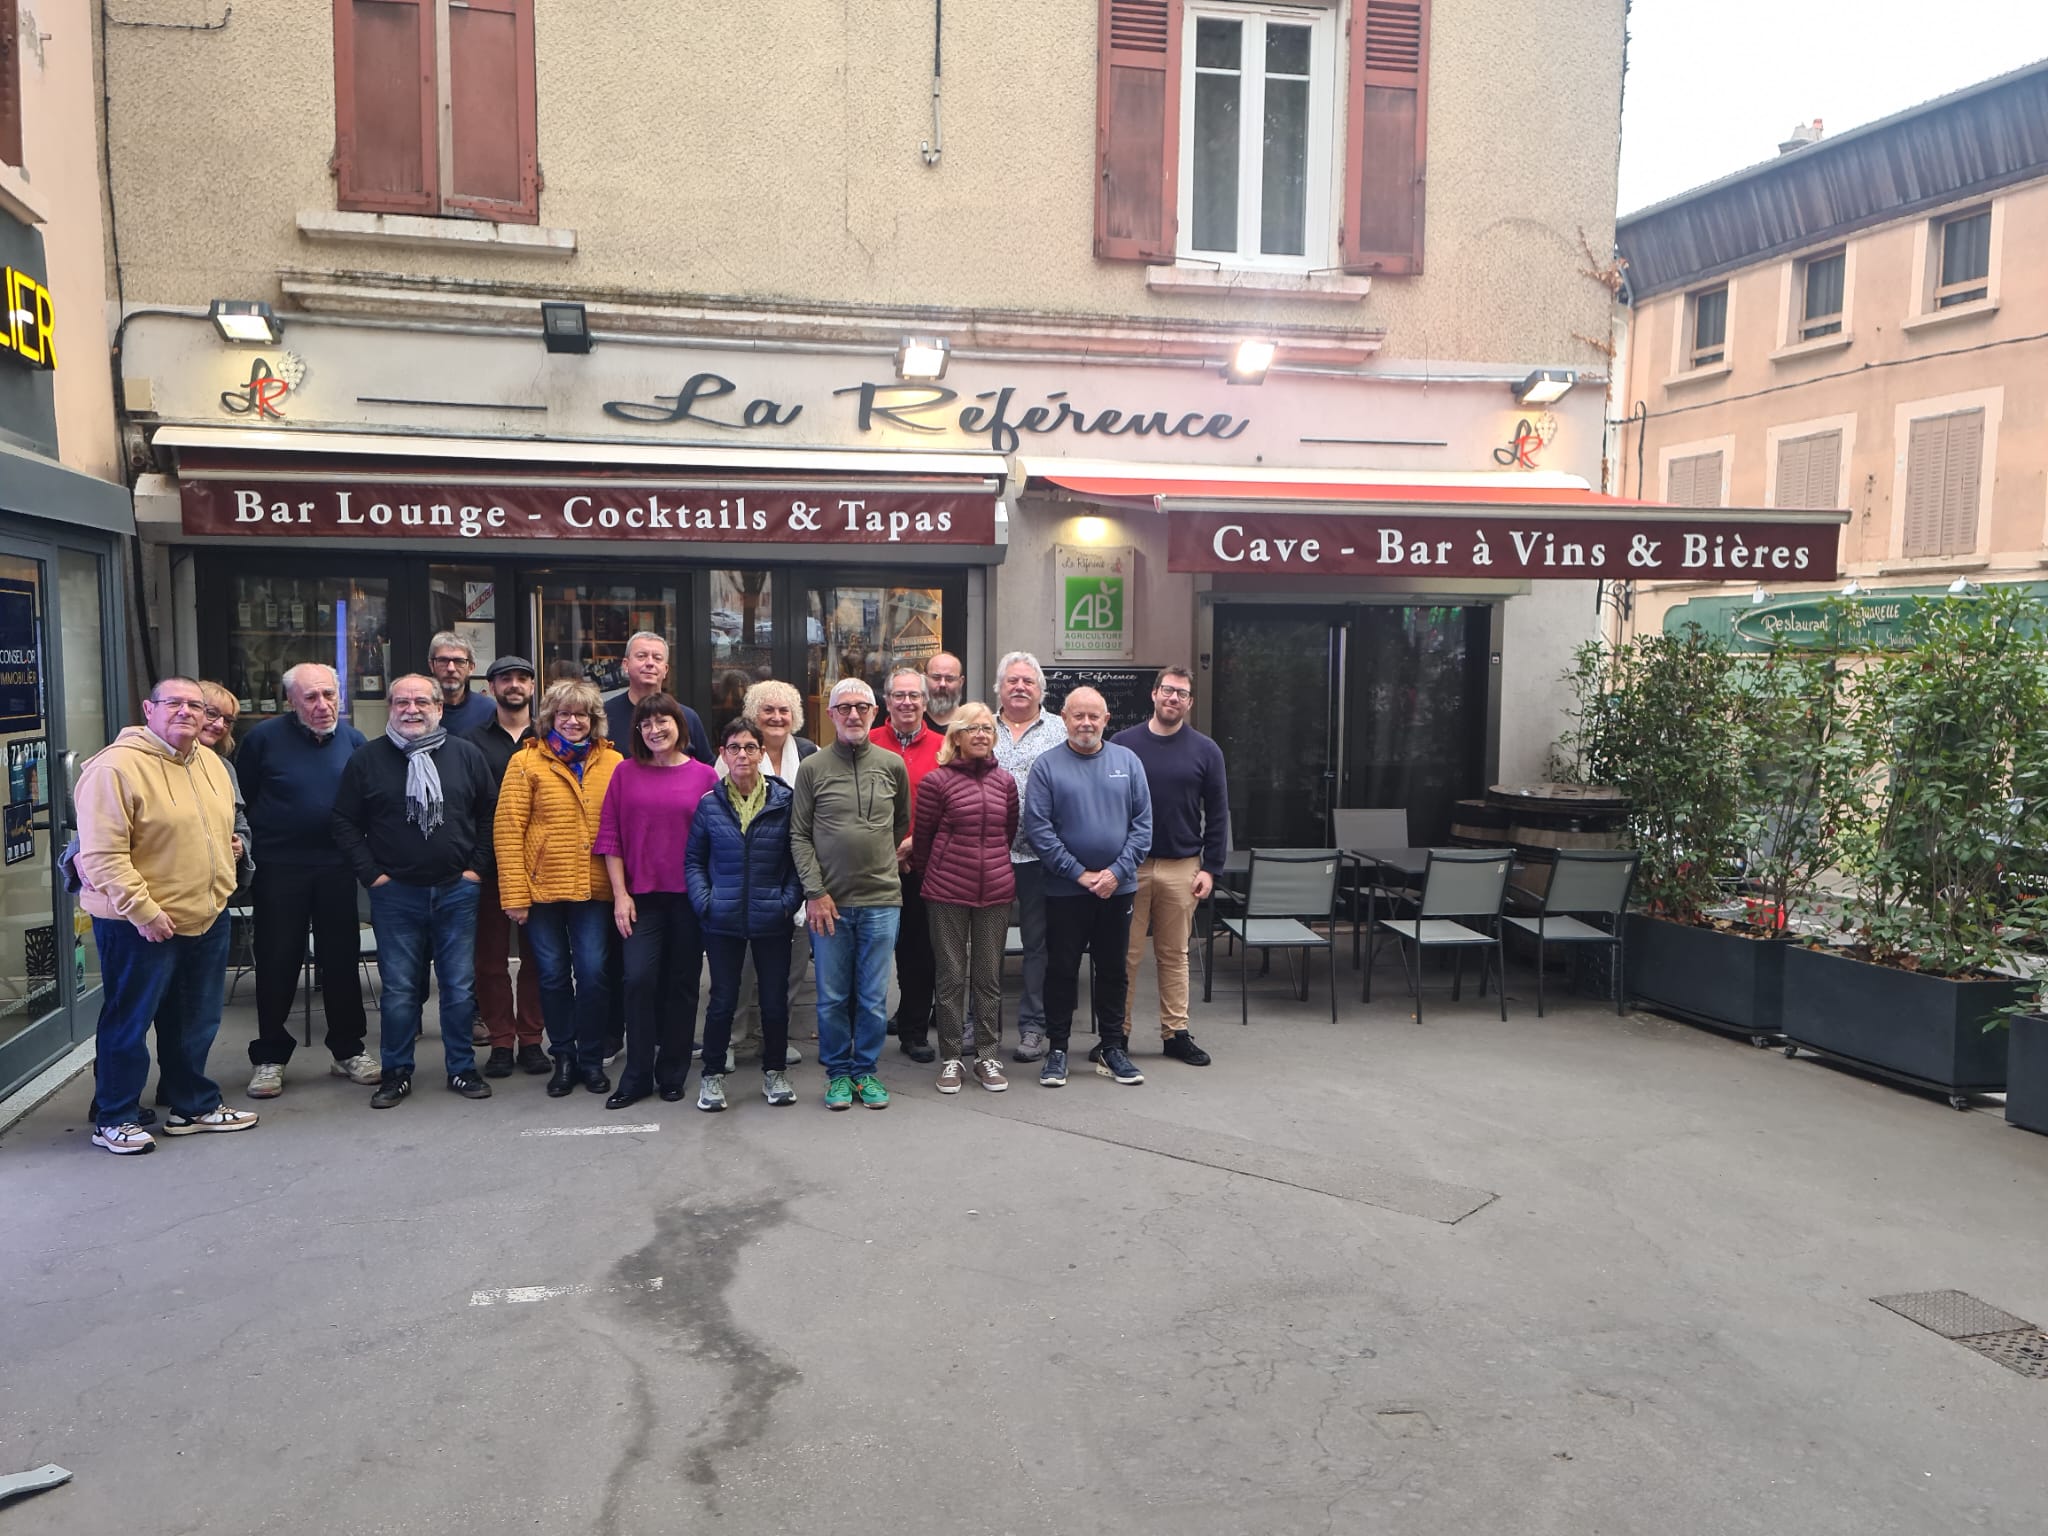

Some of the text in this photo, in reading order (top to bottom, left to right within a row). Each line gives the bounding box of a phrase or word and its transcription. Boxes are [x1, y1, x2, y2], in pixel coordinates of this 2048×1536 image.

[601, 372, 1251, 453] La Référence
[234, 490, 315, 523] Bar
[336, 491, 506, 537] Lounge
[563, 495, 767, 531] Cocktails
[788, 500, 822, 531] &
[838, 499, 953, 541] Tapas
[1212, 525, 1320, 562] Cave
[1376, 528, 1453, 564] Bar
[1472, 529, 1493, 566] à
[1509, 530, 1606, 567] Vins
[1627, 533, 1662, 567] &
[1681, 533, 1809, 569] Bières
[1068, 592, 1114, 629] AB
[1760, 609, 1829, 633] Restaurant
[1064, 632, 1122, 640] AGRICULTURE
[1064, 641, 1122, 649] BIOLOGIQUE
